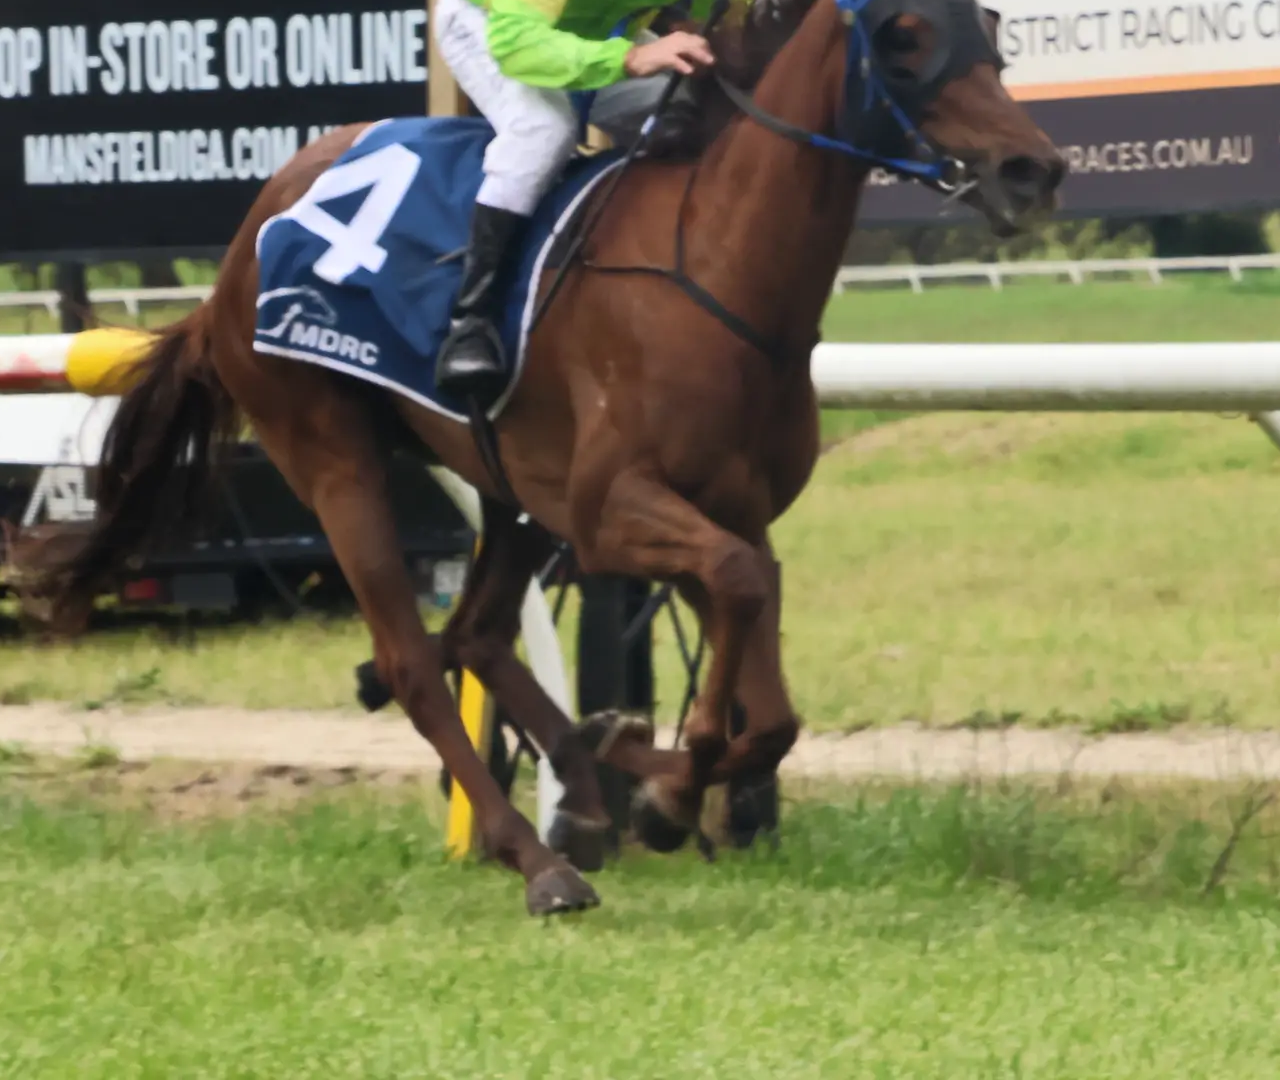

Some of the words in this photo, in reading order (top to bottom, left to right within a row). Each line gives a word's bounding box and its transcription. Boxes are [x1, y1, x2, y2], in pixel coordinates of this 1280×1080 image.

[48, 19, 218, 96] IN-STORE
[225, 15, 280, 90] OR
[285, 9, 428, 86] ONLINE
[1002, 10, 1110, 58] STRICT
[1120, 1, 1246, 50] RACING
[24, 124, 342, 185] MANSFIELDIGA.COM
[288, 142, 422, 285] 4
[288, 321, 381, 367] MDRC
